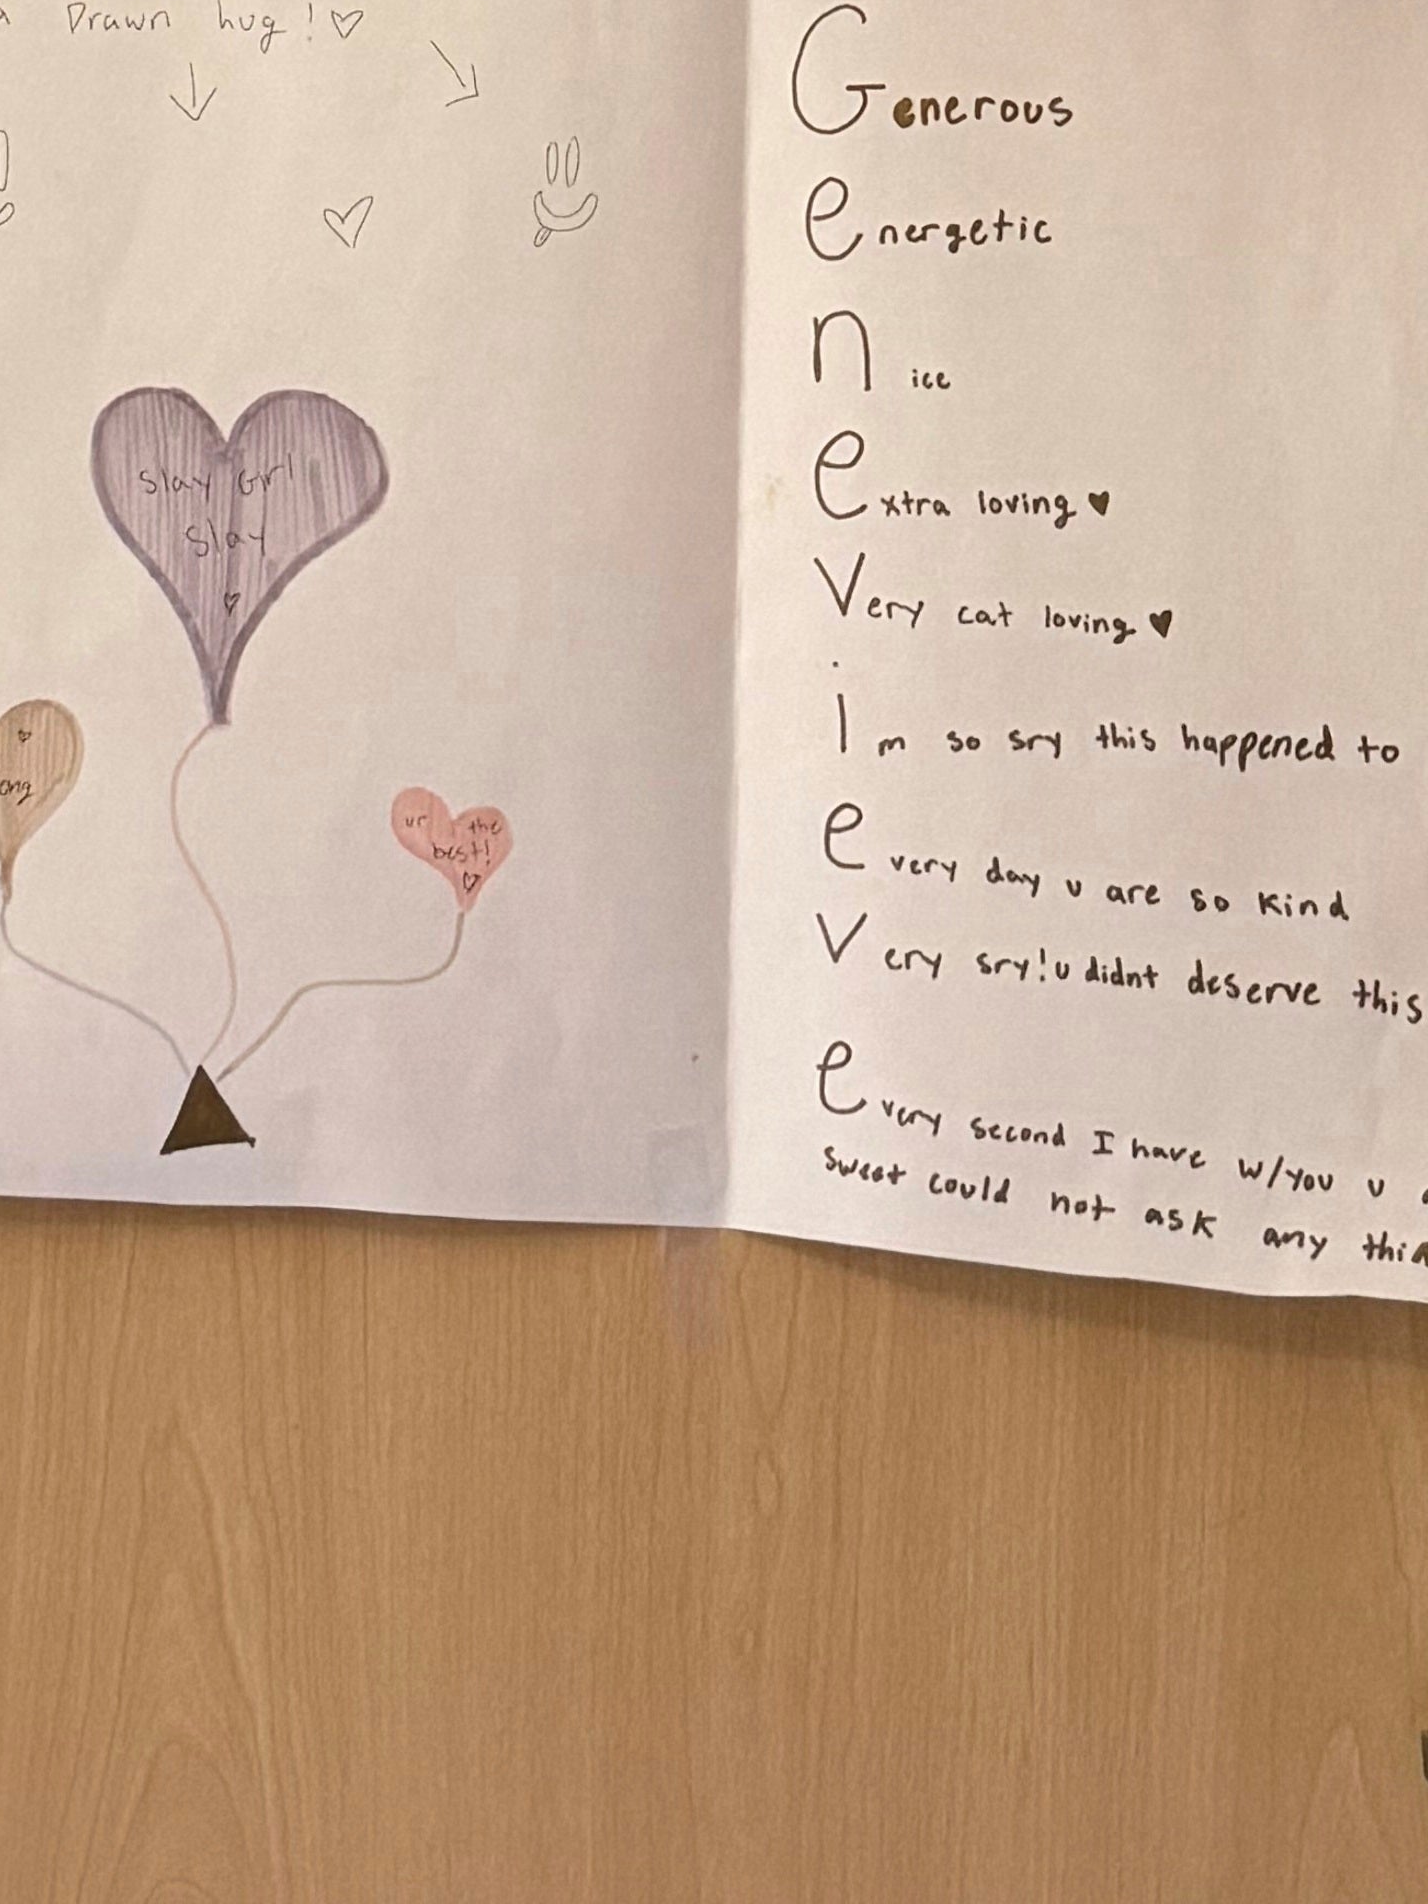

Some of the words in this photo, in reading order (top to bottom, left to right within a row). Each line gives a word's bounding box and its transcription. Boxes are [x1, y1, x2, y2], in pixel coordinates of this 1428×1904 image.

[979, 489, 1078, 529] loving
[957, 601, 1013, 628] cat
[1044, 603, 1139, 644] loving
[947, 728, 980, 753] so
[1009, 731, 1063, 761] sry
[1097, 722, 1158, 752] this
[1180, 724, 1336, 772] happened
[1358, 738, 1401, 765] to
[986, 857, 1042, 898] day
[1065, 876, 1083, 899] u
[1106, 880, 1162, 907] are
[1191, 885, 1230, 914] so
[1085, 959, 1160, 991] didnt
[1188, 961, 1322, 1009] deserve
[1353, 979, 1424, 1025] this
[971, 1117, 1066, 1147] second
[1092, 1130, 1115, 1154] I
[1132, 1139, 1206, 1169] have
[929, 1173, 1010, 1203] could
[1051, 1191, 1115, 1220] not
[1145, 1206, 1217, 1238] ask
[1264, 1227, 1327, 1260] any
